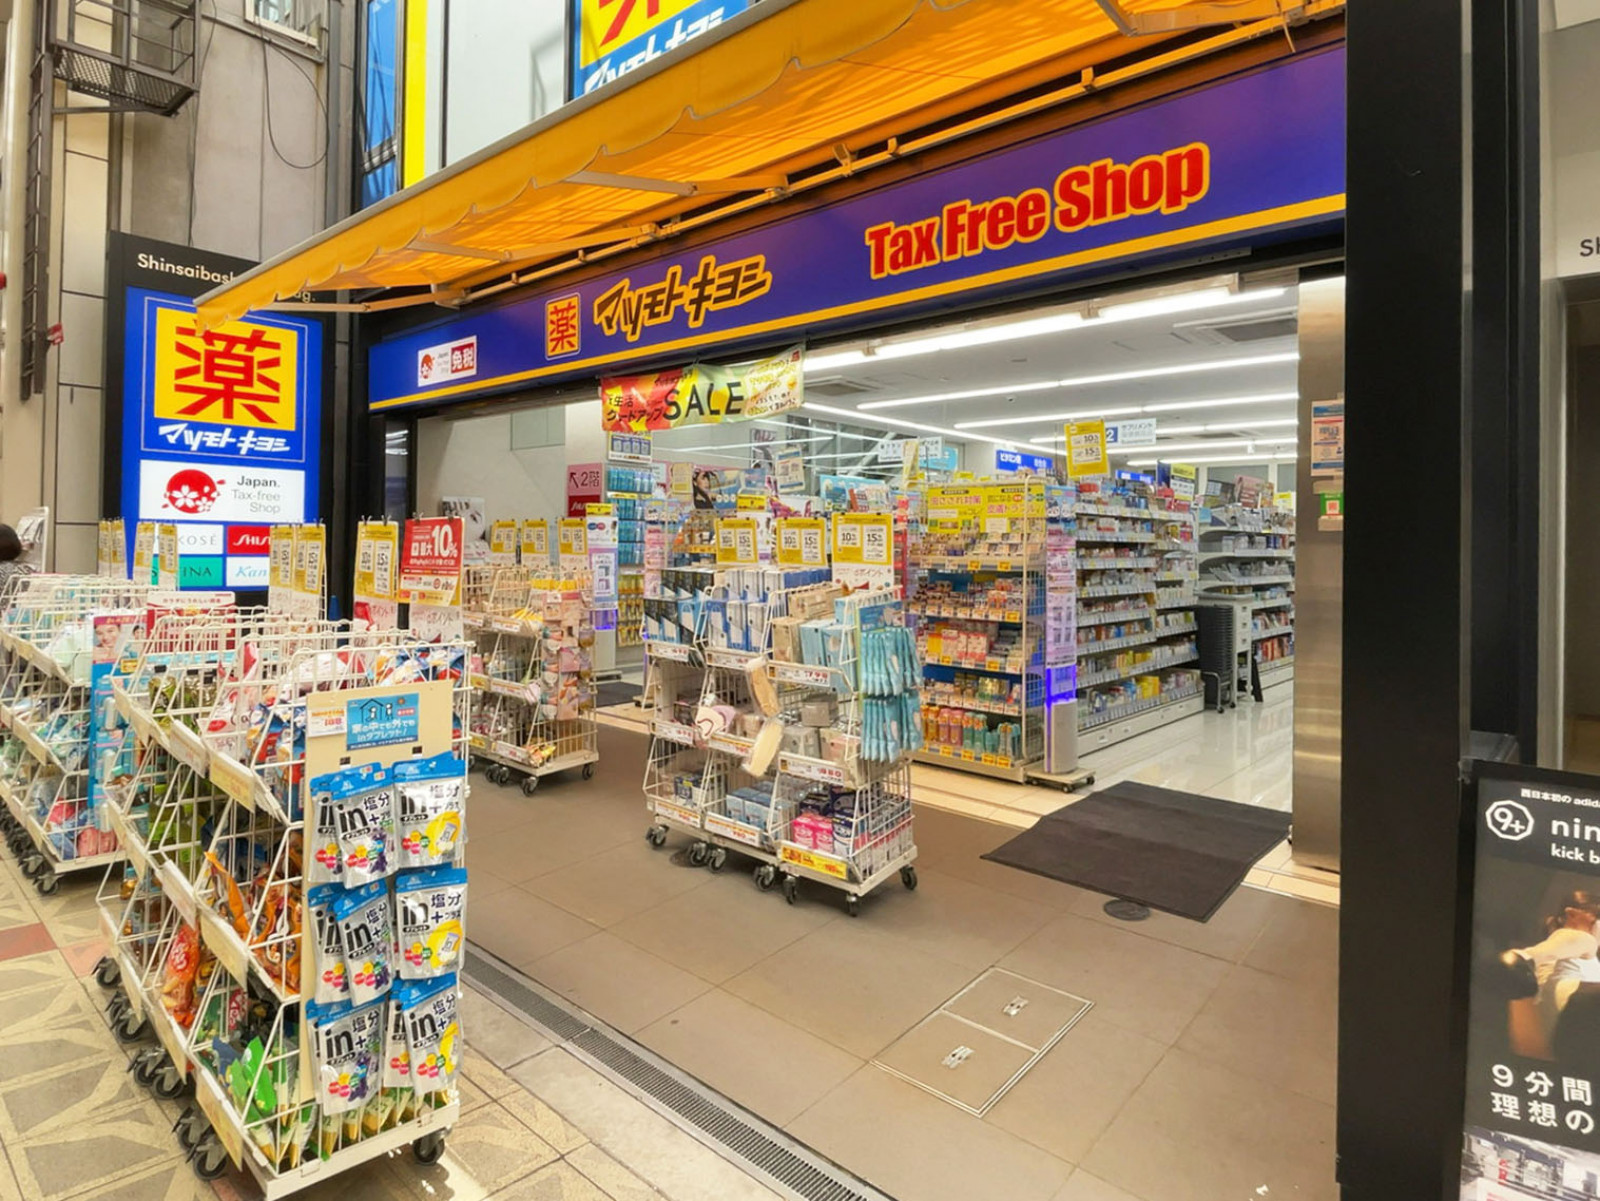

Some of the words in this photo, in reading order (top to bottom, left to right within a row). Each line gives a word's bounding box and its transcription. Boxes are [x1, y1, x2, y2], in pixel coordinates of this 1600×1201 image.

[866, 221, 940, 279] Tax
[943, 188, 1049, 260] Free
[1055, 142, 1209, 231] Shop
[595, 255, 771, 341] マツモトキヨシ
[548, 304, 577, 354] 薬
[174, 319, 281, 424] 薬
[663, 381, 744, 420] SALE
[158, 423, 291, 455] マツモトキヨシ
[231, 489, 281, 501] Tax-free
[249, 502, 281, 515] Shop
[363, 791, 390, 810] 塩分
[337, 804, 368, 833] in
[1551, 842, 1585, 862] kick
[431, 893, 461, 908] 塩分
[345, 922, 372, 952] in
[352, 1010, 380, 1032] 塩分
[409, 1012, 437, 1041] in
[325, 1029, 354, 1059] in
[1491, 1064, 1592, 1106] 9分間
[1490, 1092, 1594, 1134] 理想の
